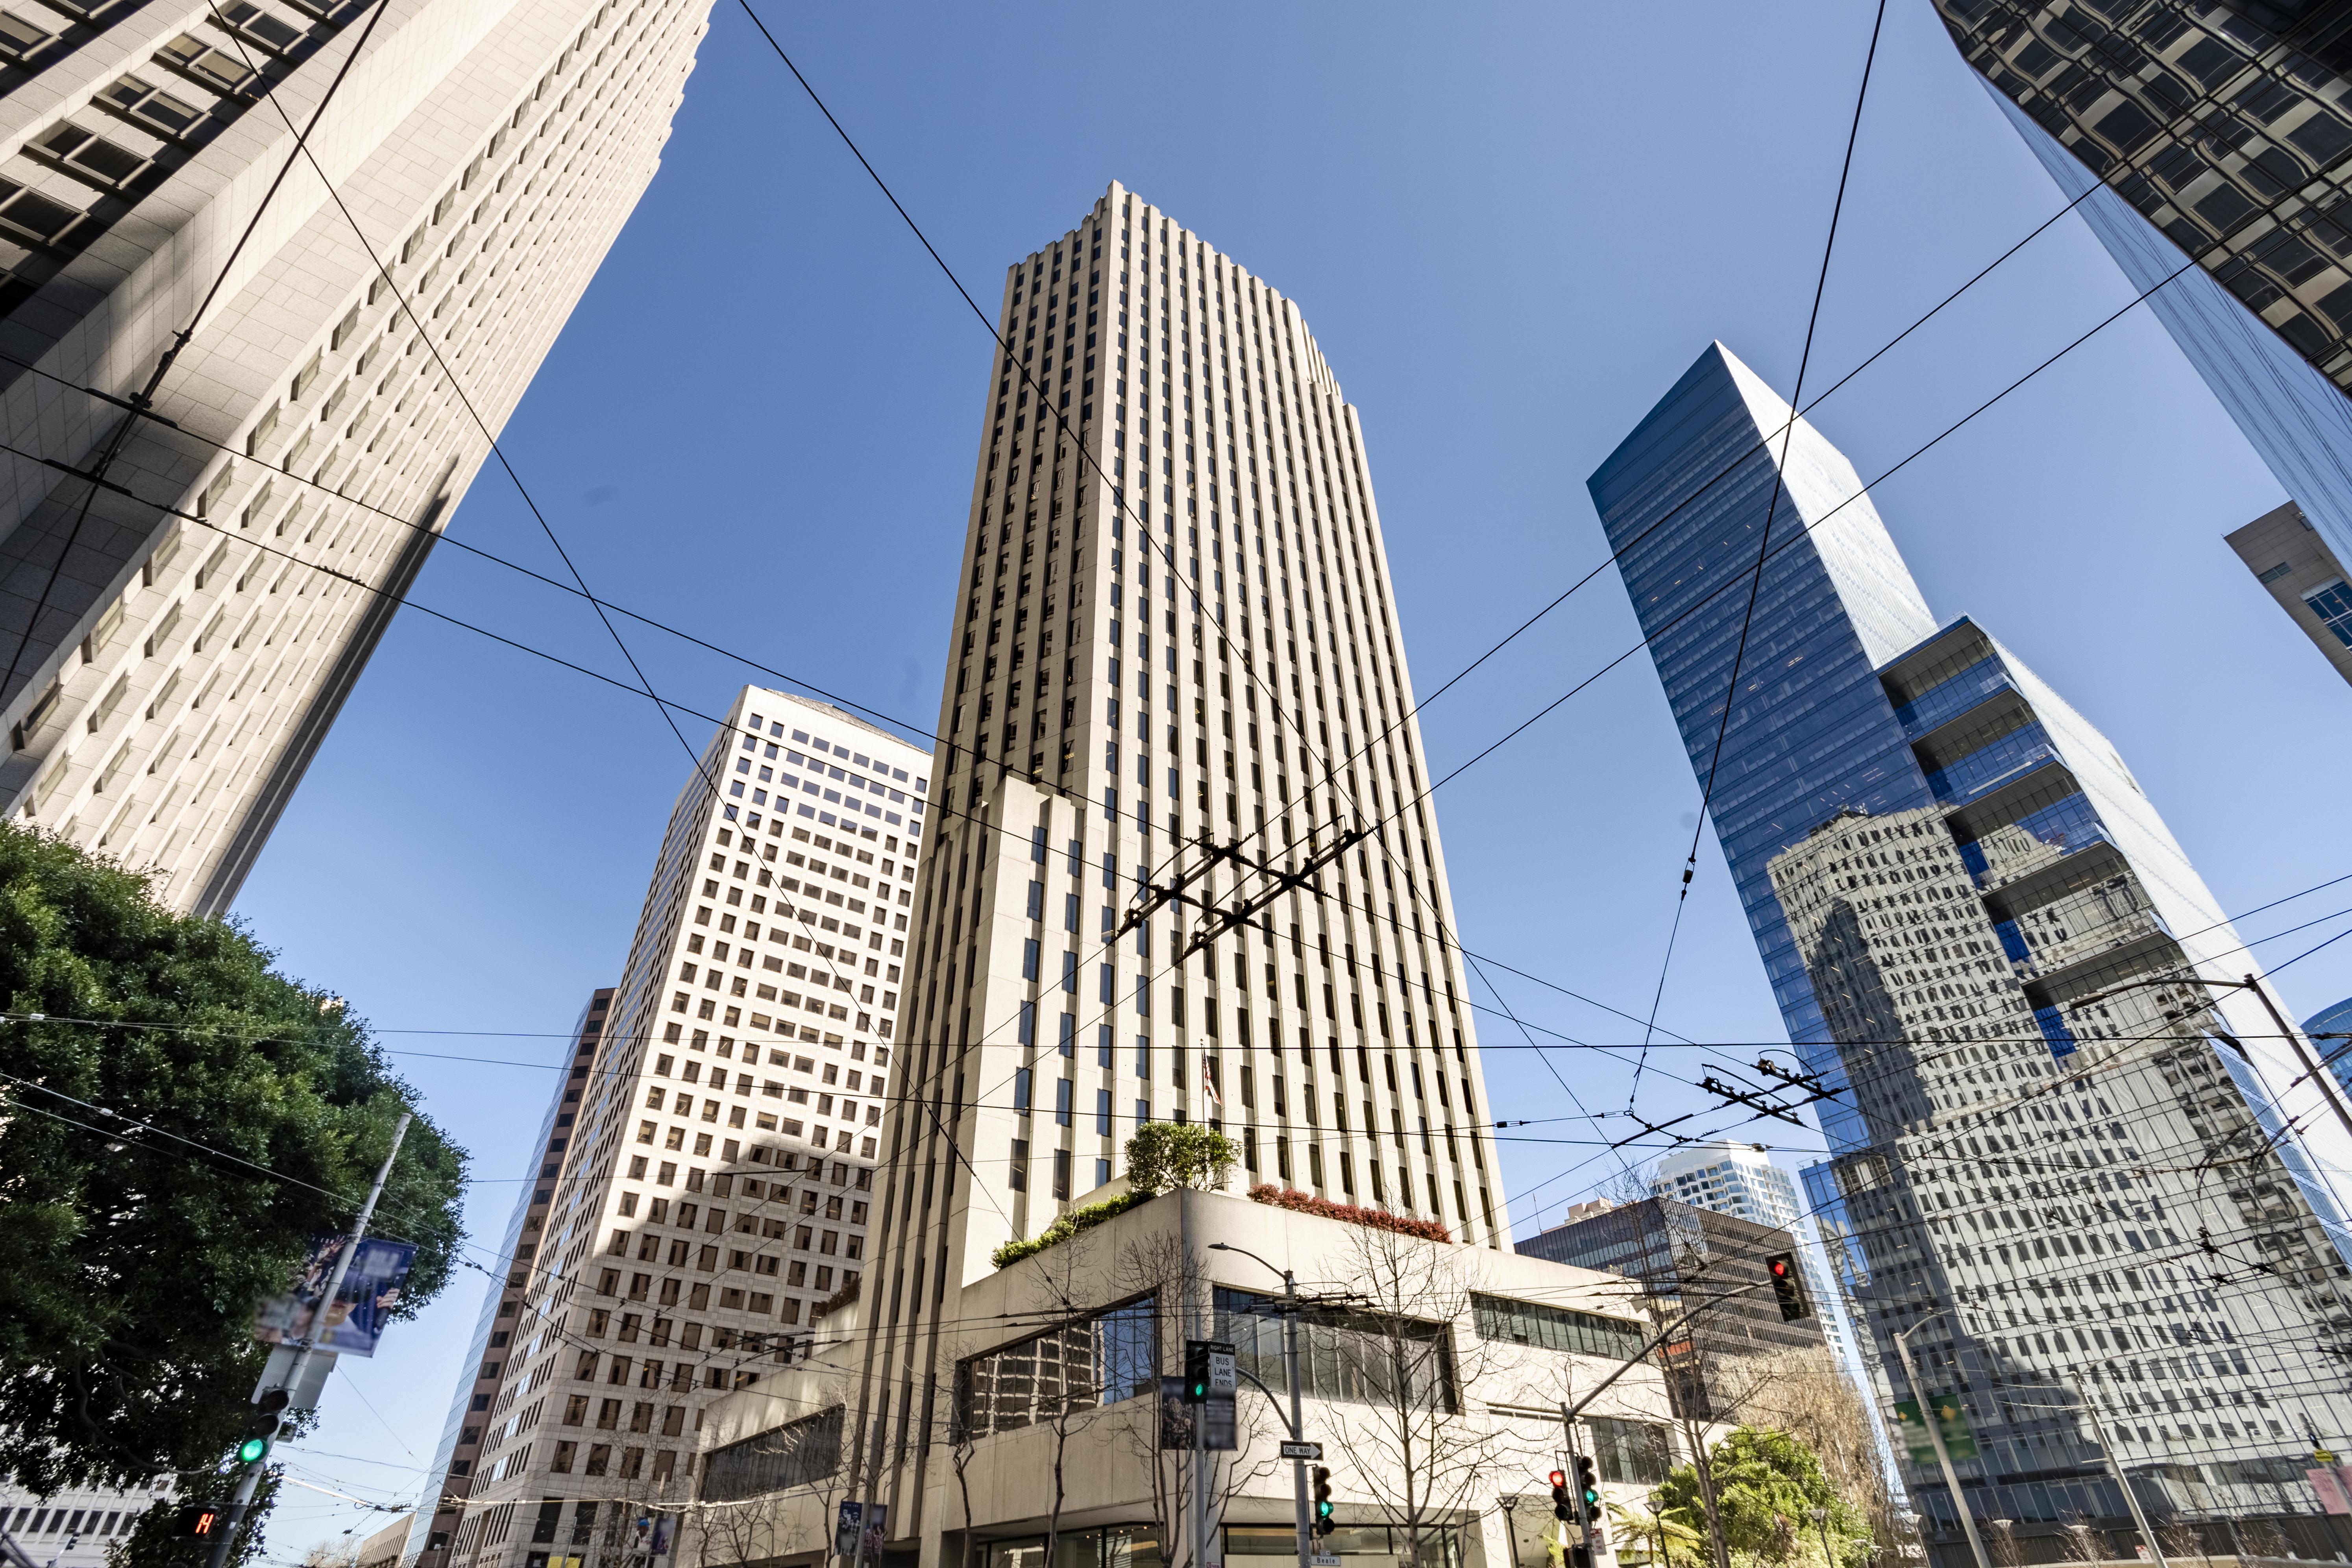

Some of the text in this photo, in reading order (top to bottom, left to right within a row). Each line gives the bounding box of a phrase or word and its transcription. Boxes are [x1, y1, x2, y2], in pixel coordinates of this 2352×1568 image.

[1216, 1356, 1229, 1366] BUS
[1215, 1367, 1231, 1377] LANE
[1215, 1379, 1232, 1387] ENDS
[196, 1513, 214, 1534] 14
